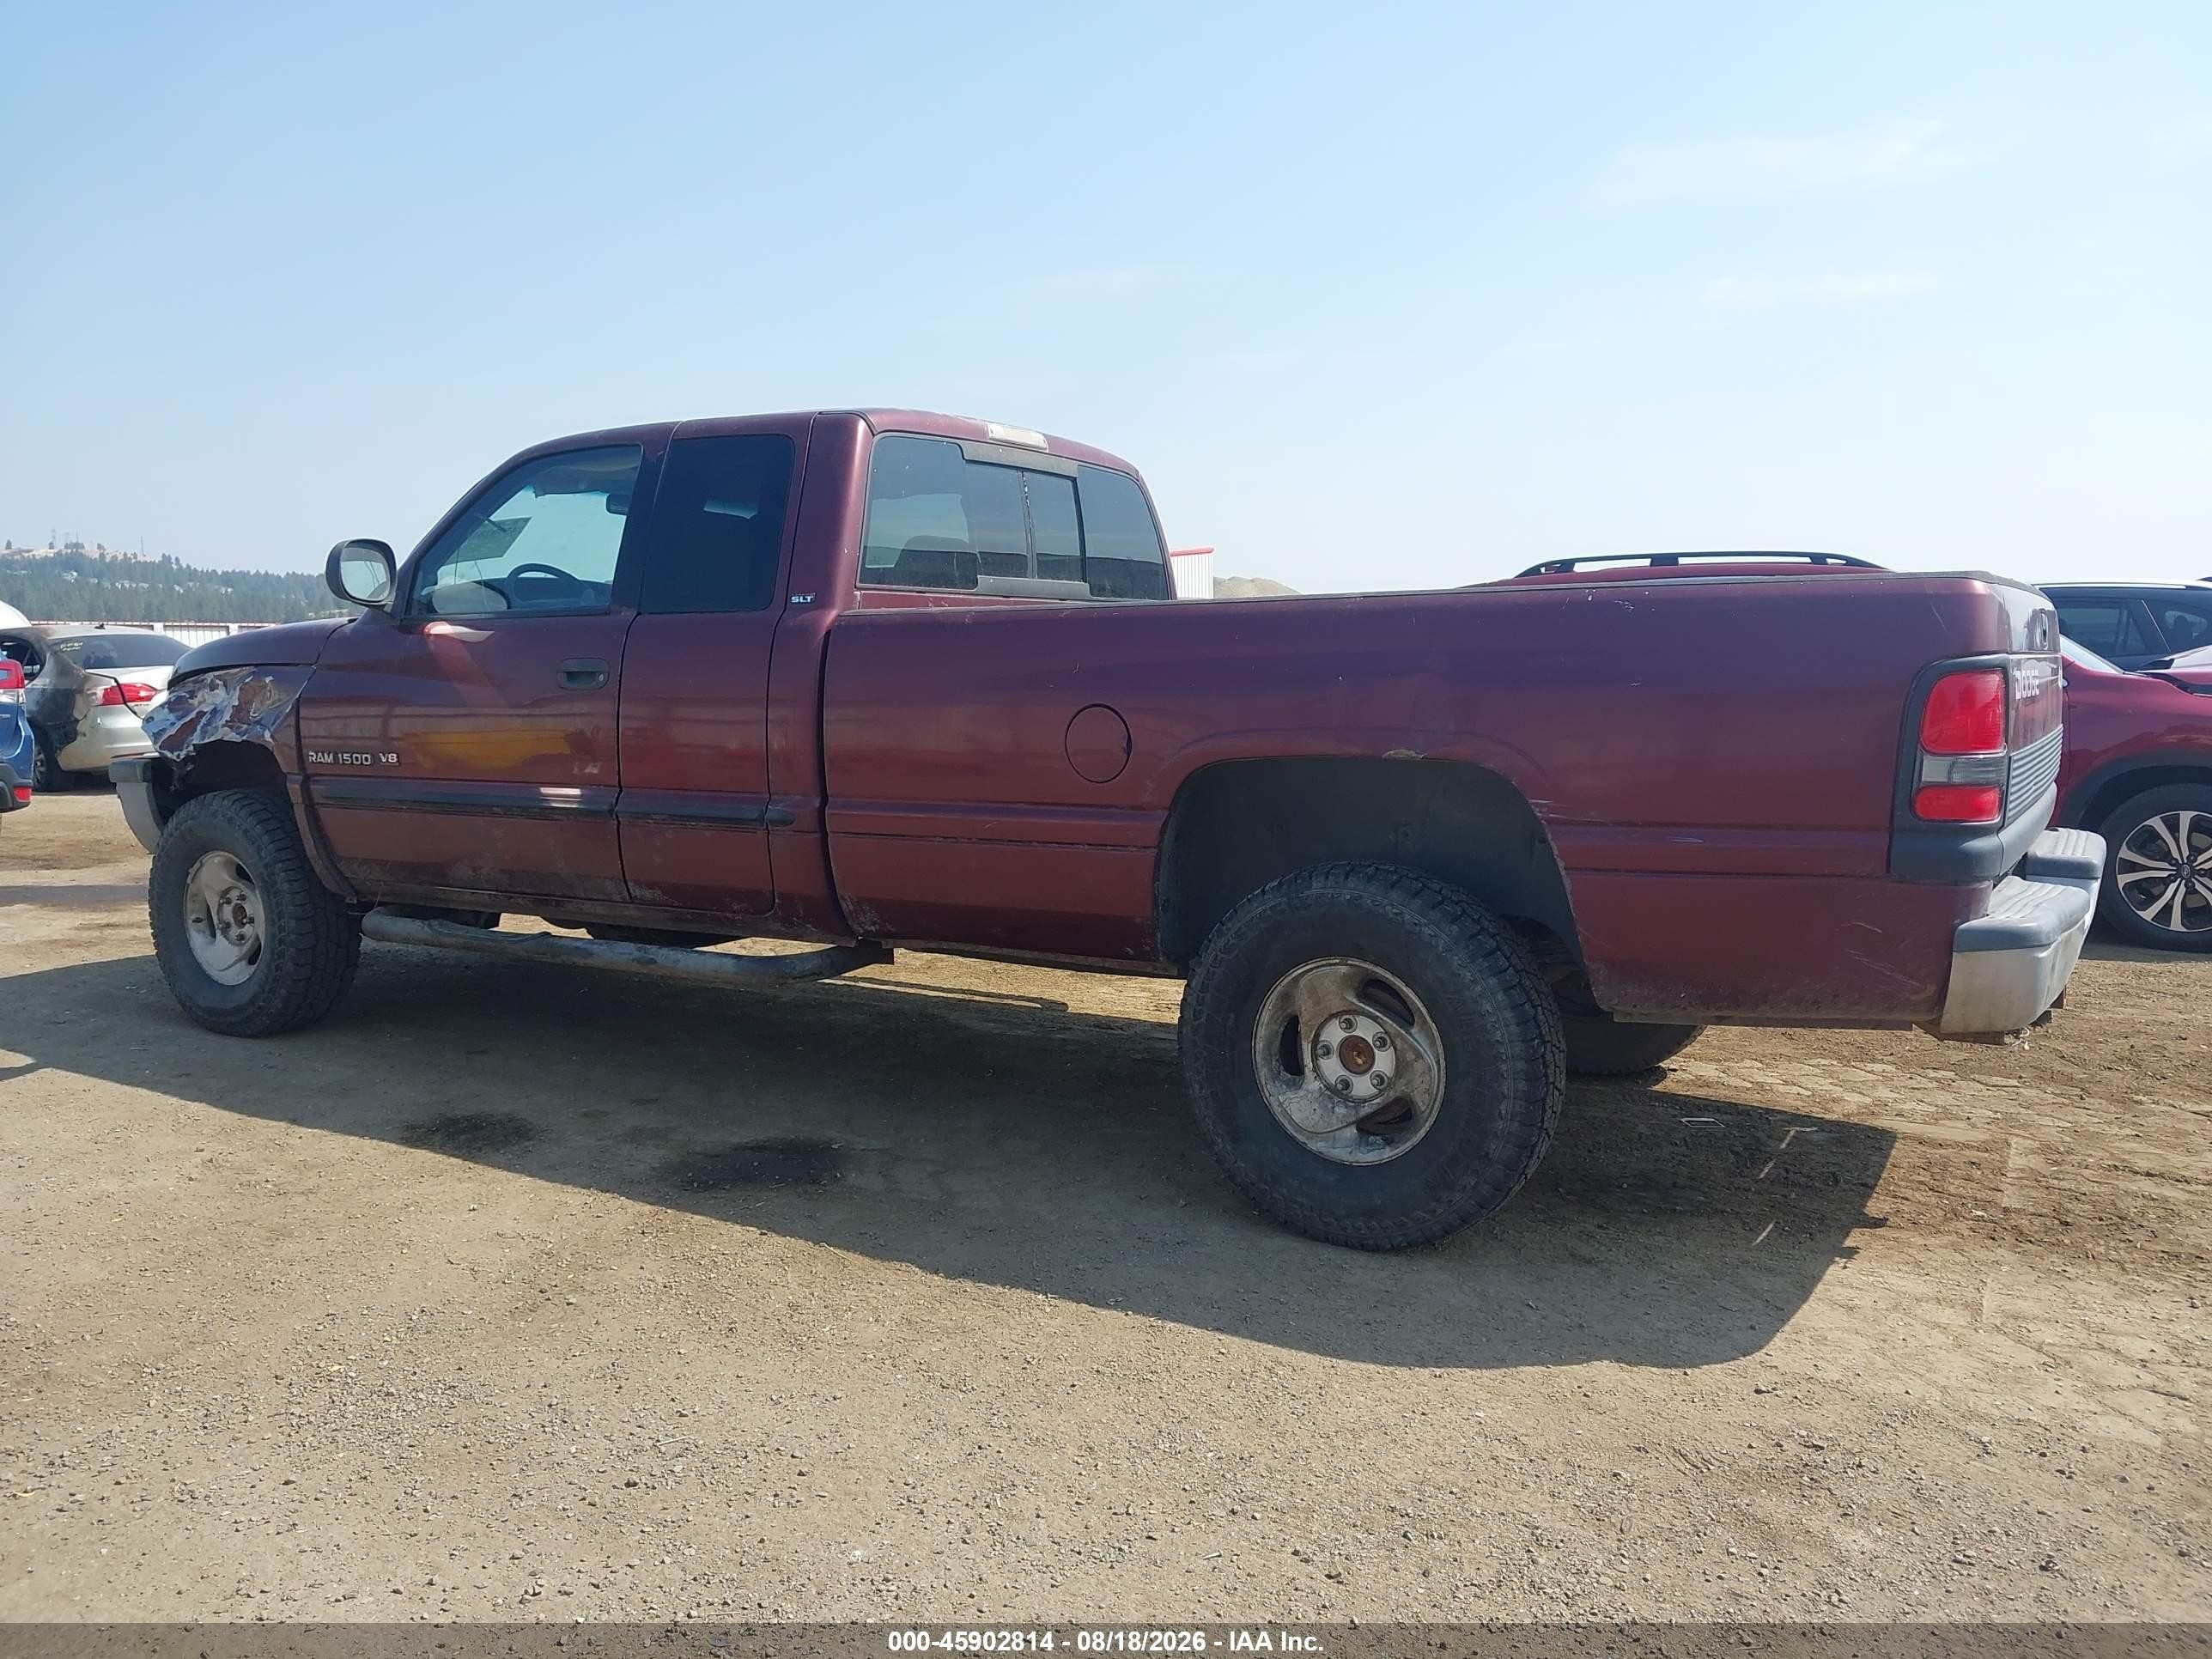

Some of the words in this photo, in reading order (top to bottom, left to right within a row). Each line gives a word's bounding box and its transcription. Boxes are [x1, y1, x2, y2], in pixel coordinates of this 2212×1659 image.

[308, 750, 334, 763] RAM
[338, 752, 372, 765] 1500
[379, 752, 398, 763] V8
